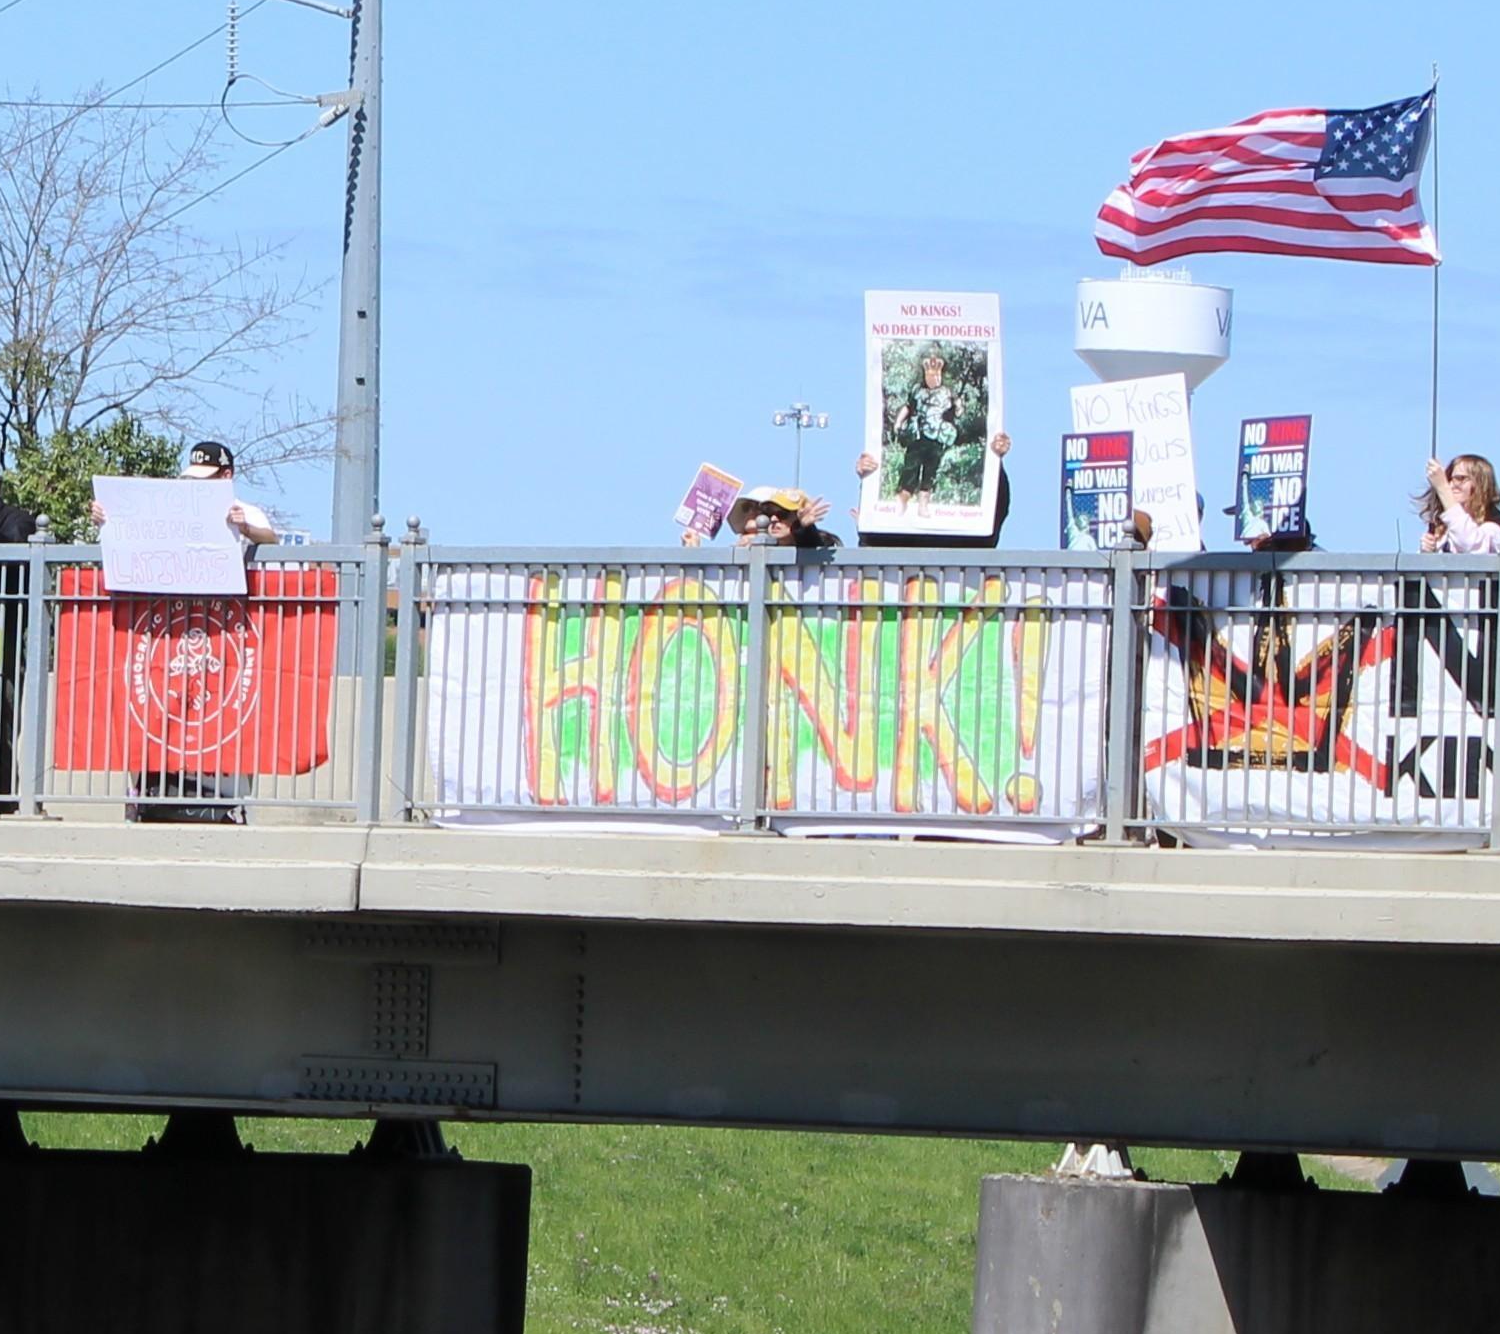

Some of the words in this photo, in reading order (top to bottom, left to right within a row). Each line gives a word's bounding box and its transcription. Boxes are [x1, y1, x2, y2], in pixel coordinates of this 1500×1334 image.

[901, 305, 917, 316] NO
[920, 305, 962, 317] KINGS!
[1080, 301, 1109, 329] VA
[872, 323, 889, 335] NO
[892, 323, 929, 336] DRAFT
[933, 324, 996, 337] DODGERS!
[1075, 394, 1111, 428] NO
[1244, 423, 1267, 446] NO
[1066, 438, 1088, 461] NO
[1250, 454, 1270, 474] NO
[1272, 452, 1304, 472] WAR
[1074, 470, 1093, 489] NO
[1095, 468, 1128, 487] WAR
[1272, 477, 1303, 506] NO
[117, 482, 214, 517] STOP
[1098, 493, 1128, 521] NO
[1271, 507, 1300, 533] ICE
[112, 549, 229, 586] LATINAS
[523, 569, 1054, 815] HONK!
